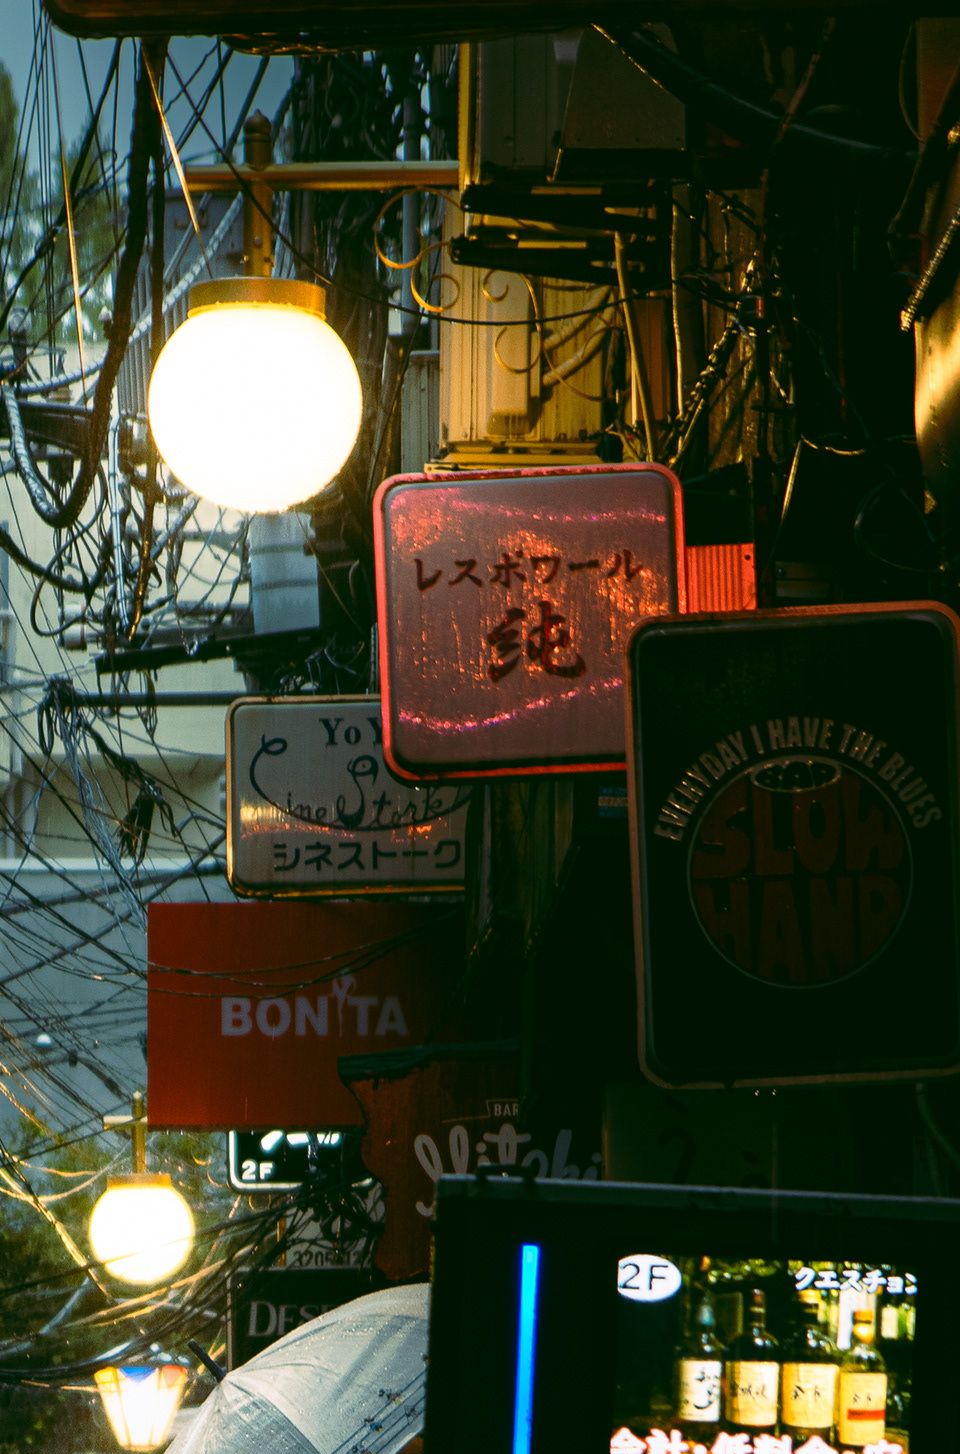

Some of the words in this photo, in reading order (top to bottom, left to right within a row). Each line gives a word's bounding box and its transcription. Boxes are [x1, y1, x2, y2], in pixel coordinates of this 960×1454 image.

[653, 730, 747, 841] EVERYDAY
[767, 716, 835, 750] HAVE
[842, 722, 888, 768] THE
[877, 751, 943, 829] BLUES
[273, 841, 461, 872] シネストーク
[692, 765, 904, 879] SLOW
[693, 873, 902, 984] HAND
[241, 1158, 276, 1181] 2F
[618, 1263, 668, 1291] 2F
